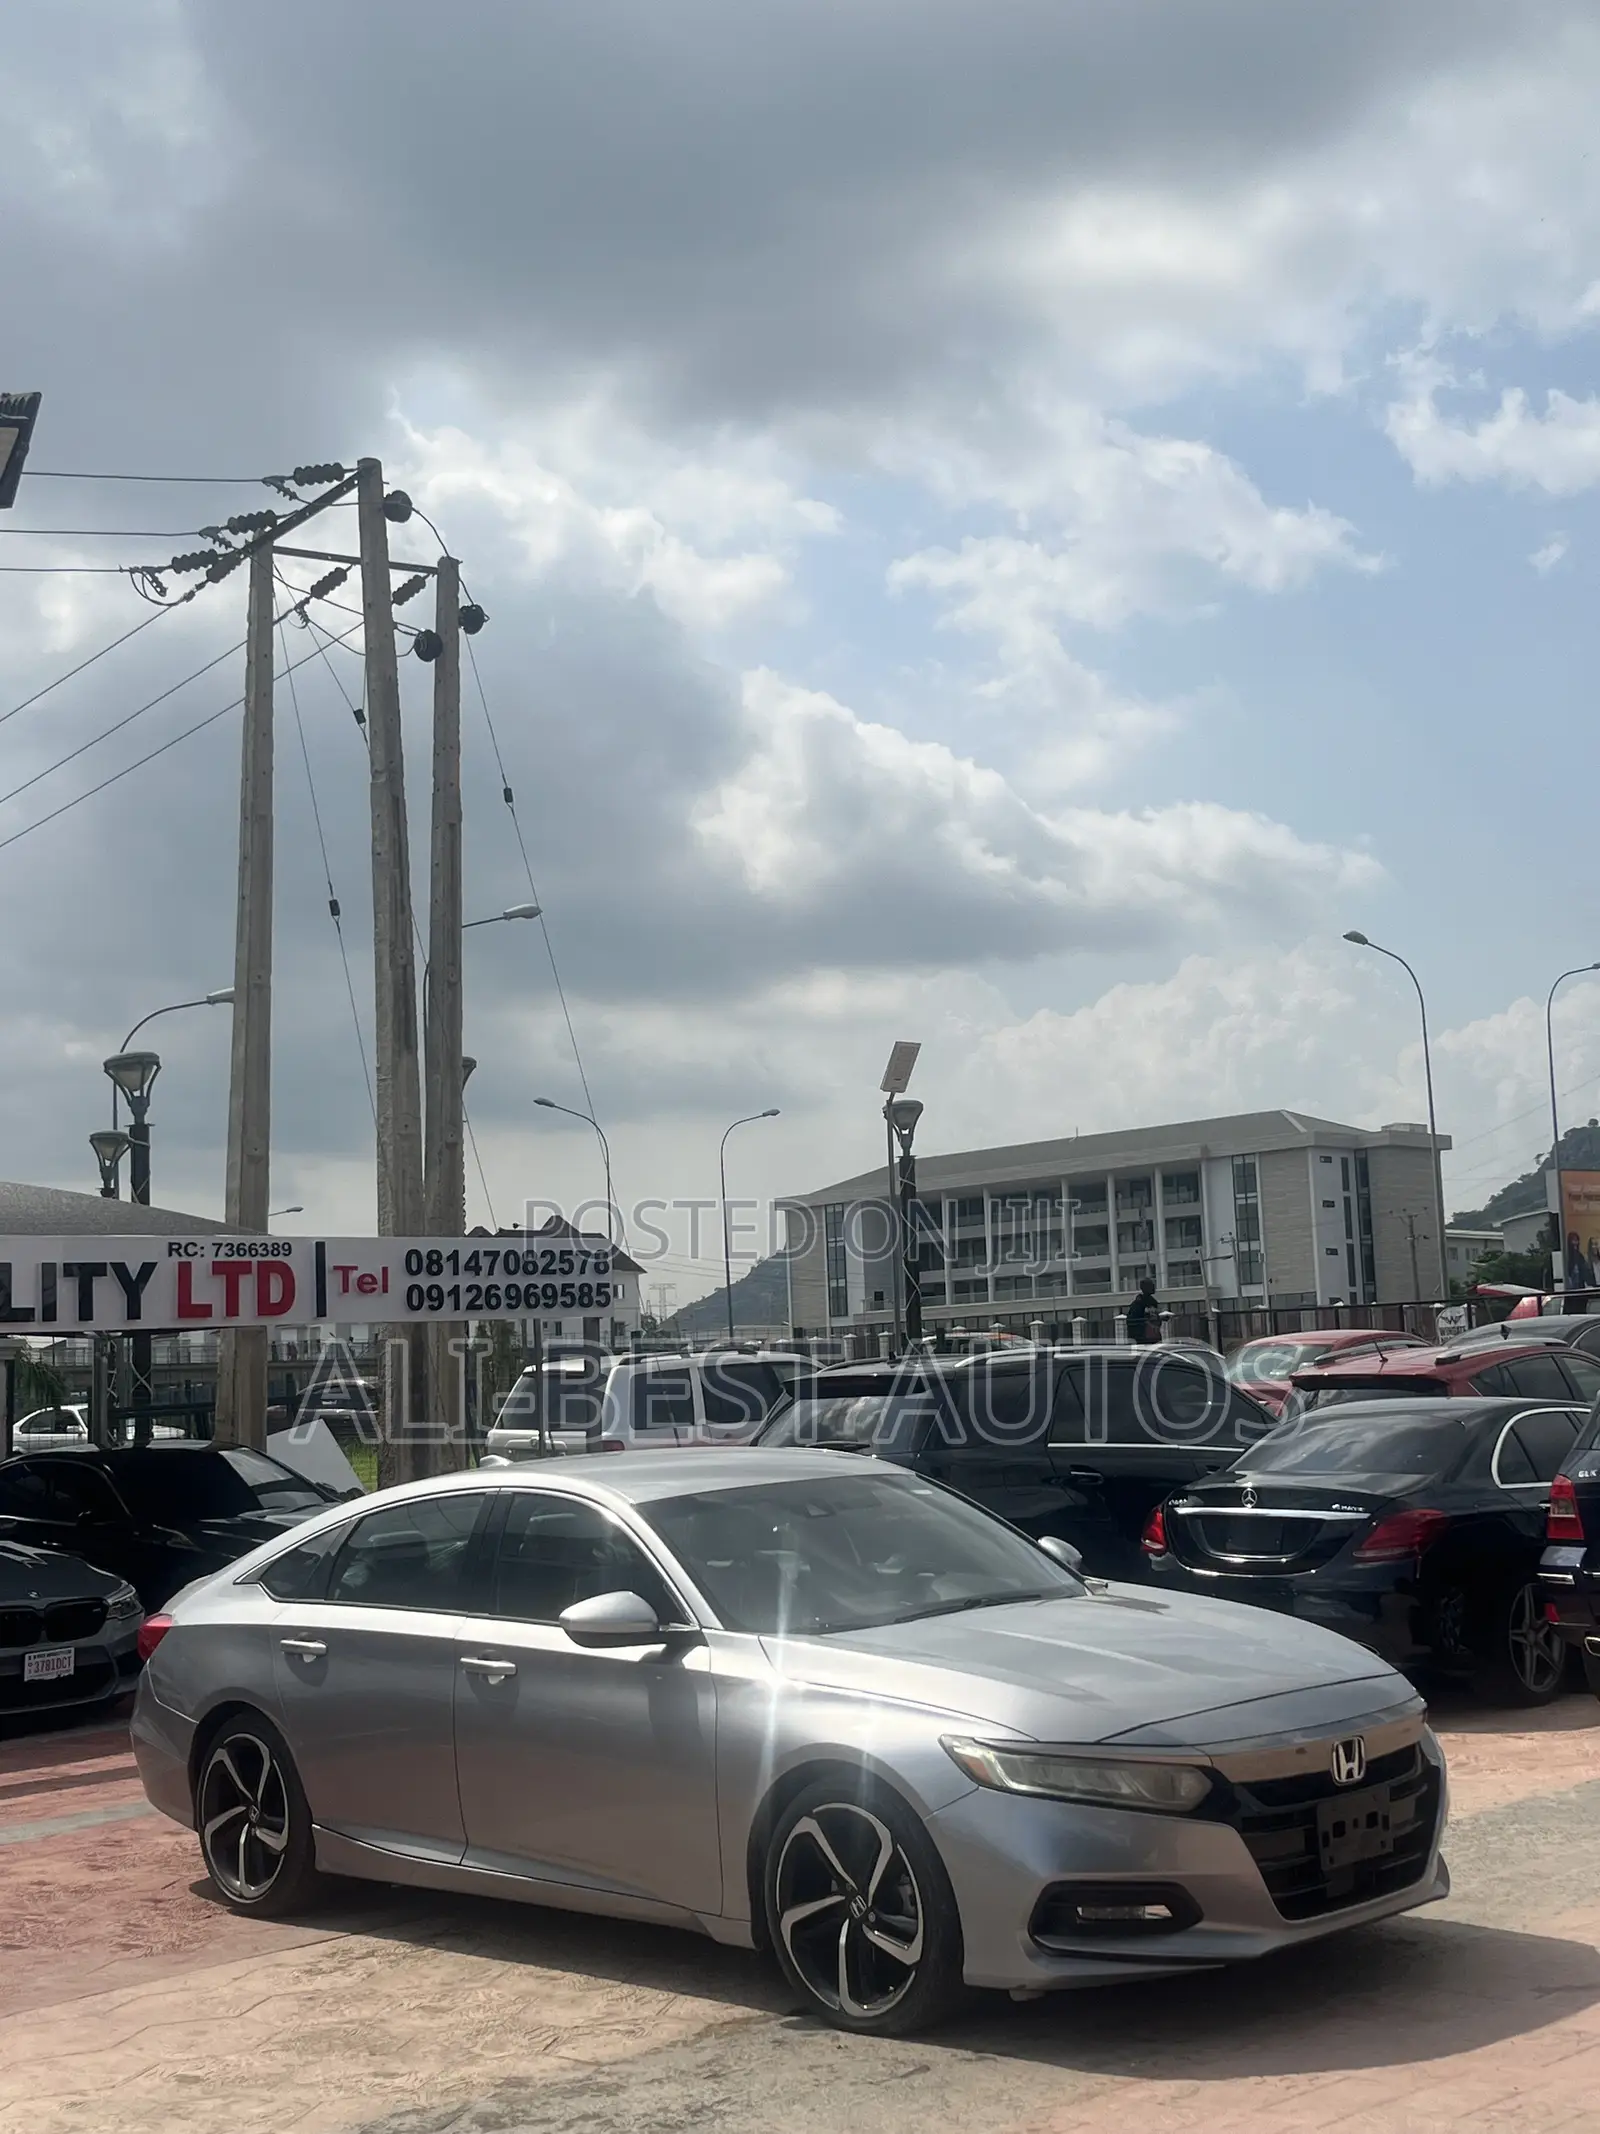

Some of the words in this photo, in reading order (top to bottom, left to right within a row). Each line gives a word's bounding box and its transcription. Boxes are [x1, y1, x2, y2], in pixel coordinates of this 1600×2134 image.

[167, 1242, 205, 1258] RC:
[212, 1242, 292, 1258] 7366389
[405, 1249, 610, 1277] 08147082578
[177, 1261, 296, 1319] LTD
[333, 1265, 389, 1295] Tel
[406, 1283, 612, 1312] 09126969585
